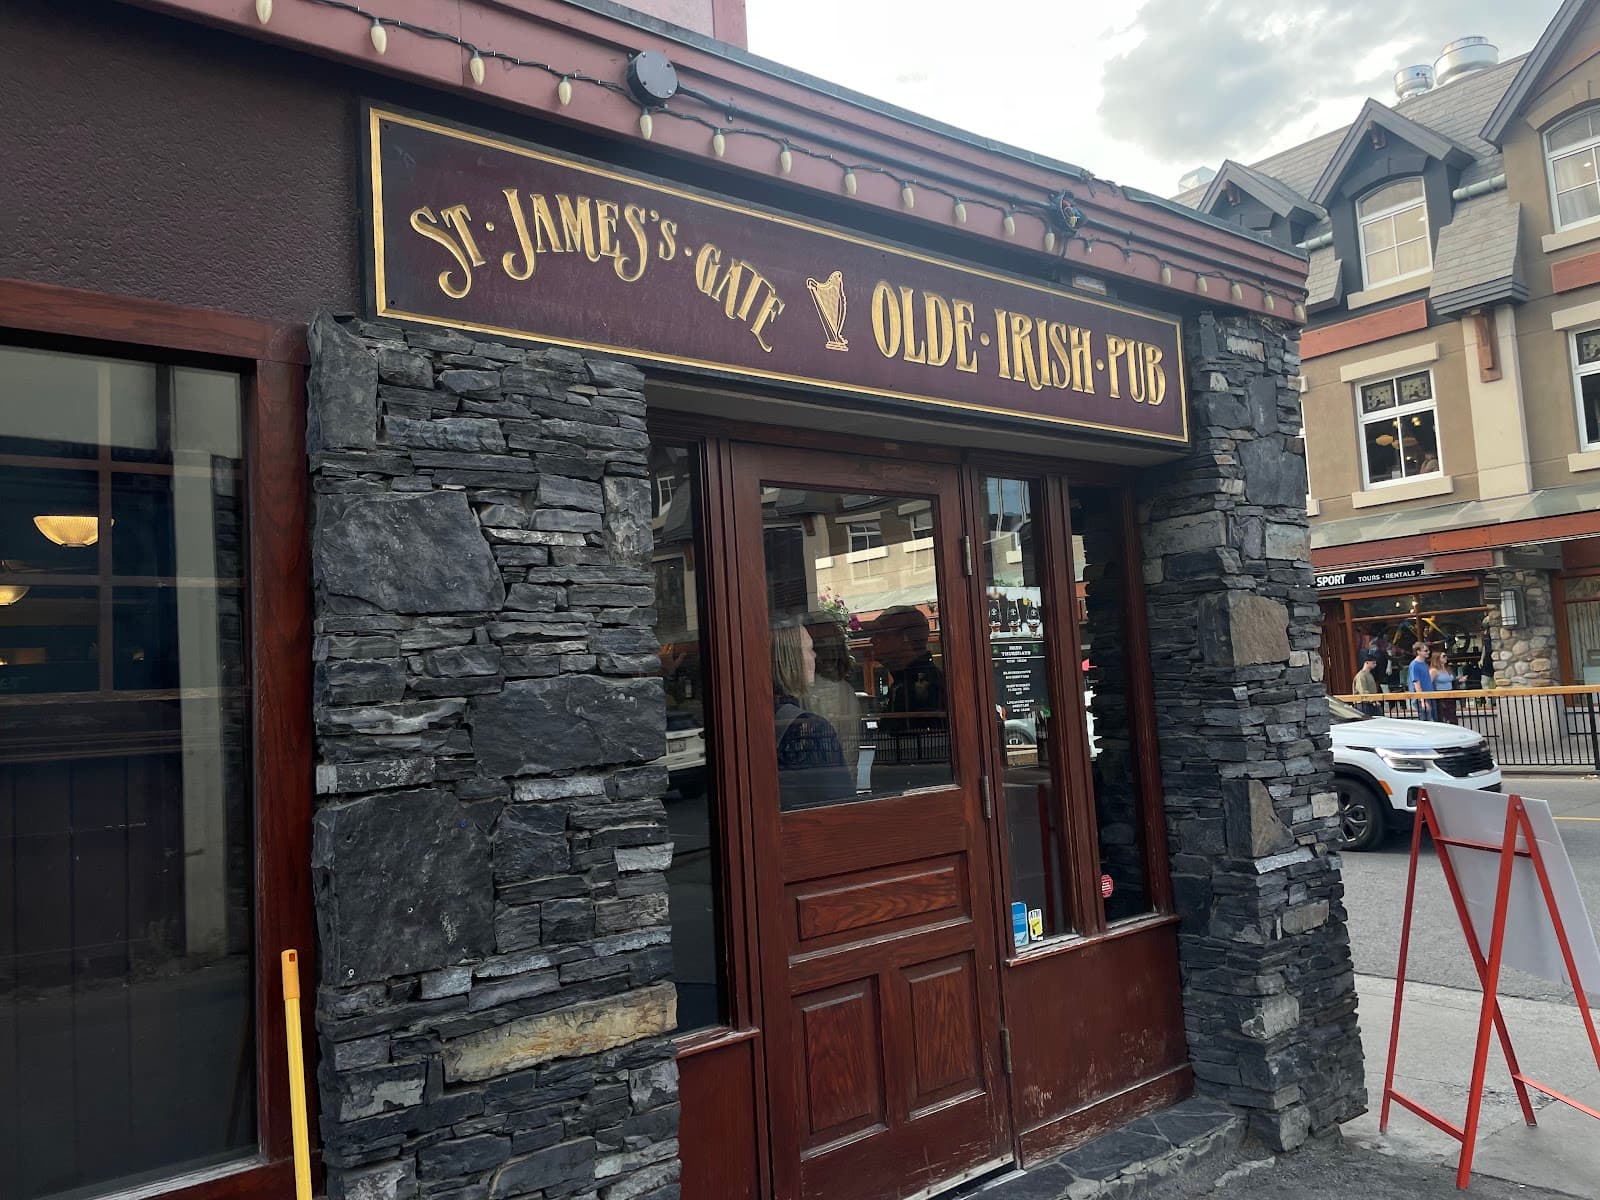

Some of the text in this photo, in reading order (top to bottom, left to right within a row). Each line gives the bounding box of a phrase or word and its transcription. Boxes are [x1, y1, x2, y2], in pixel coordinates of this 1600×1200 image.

[410, 188, 1166, 406] ST JAMES'S GATE OLDE IRISH PUB
[1317, 574, 1346, 587] SPORT
[1358, 574, 1380, 583] TOURS
[1386, 570, 1416, 580] RENTALS
